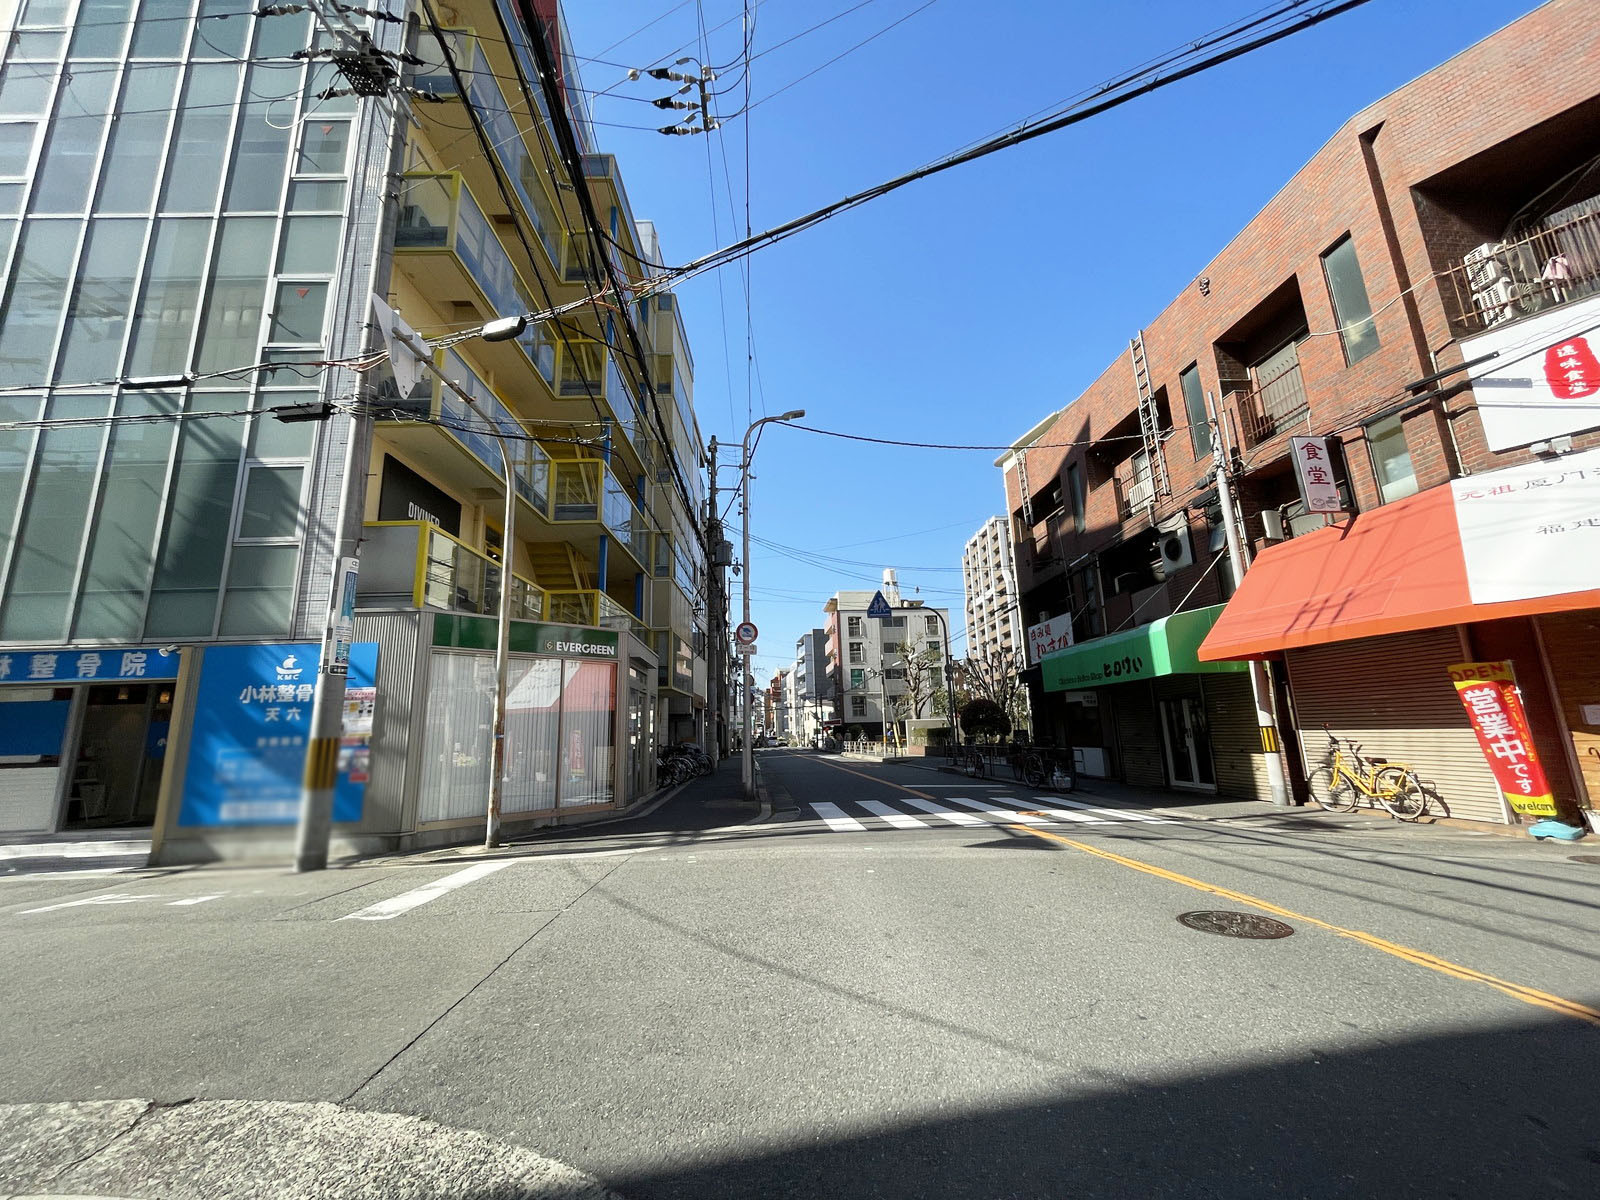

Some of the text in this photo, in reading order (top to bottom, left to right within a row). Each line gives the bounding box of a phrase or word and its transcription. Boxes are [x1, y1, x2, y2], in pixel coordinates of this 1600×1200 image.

[1300, 442, 1331, 485] 食堂
[1458, 467, 1600, 502] 元祖厦门
[556, 641, 615, 655] EVERGREEN
[1448, 663, 1505, 682] OPEN
[240, 684, 315, 704] 小林整骨
[264, 707, 302, 721] 天六
[1463, 687, 1533, 794] 営業中です
